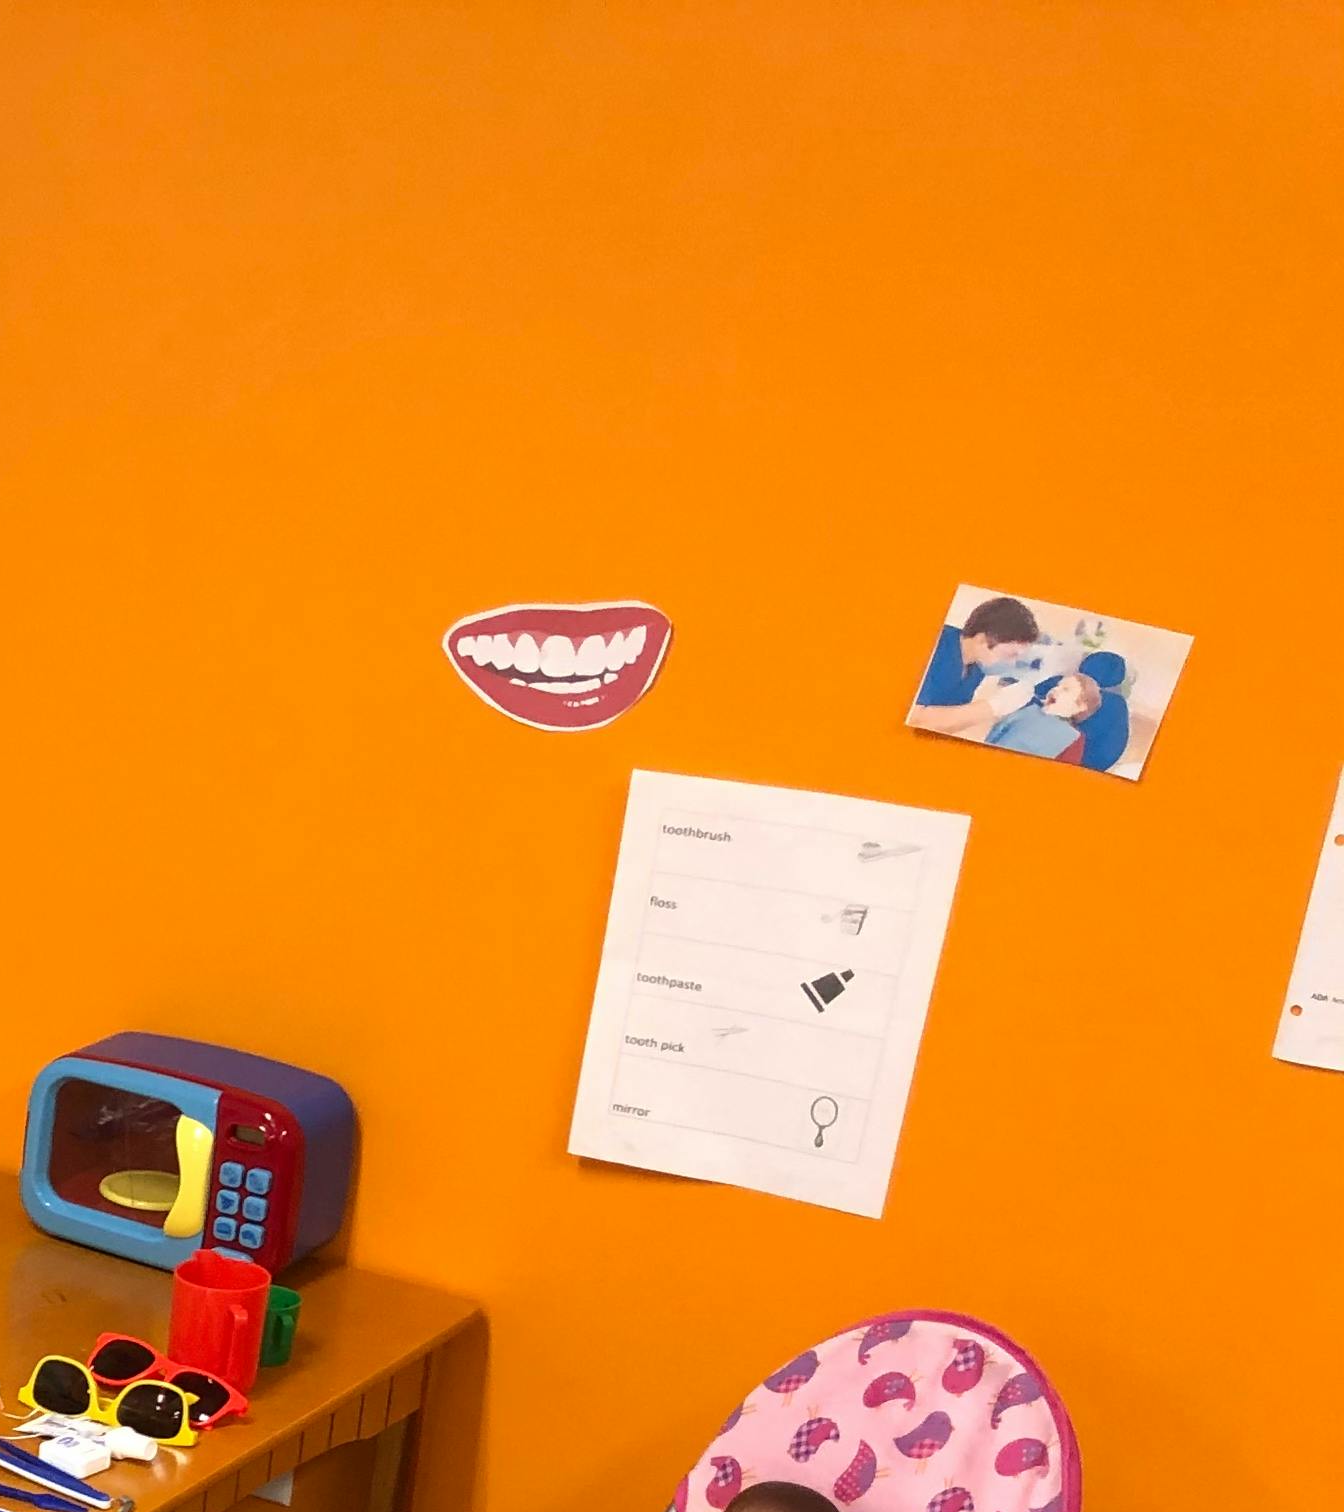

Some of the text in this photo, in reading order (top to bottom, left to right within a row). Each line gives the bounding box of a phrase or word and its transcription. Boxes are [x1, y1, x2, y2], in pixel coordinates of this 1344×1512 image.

[662, 824, 732, 843] toothbrush
[650, 895, 678, 910] floss
[636, 972, 703, 992] toothpaste
[625, 1035, 685, 1053] tooth pick
[612, 1103, 650, 1117] mirror
